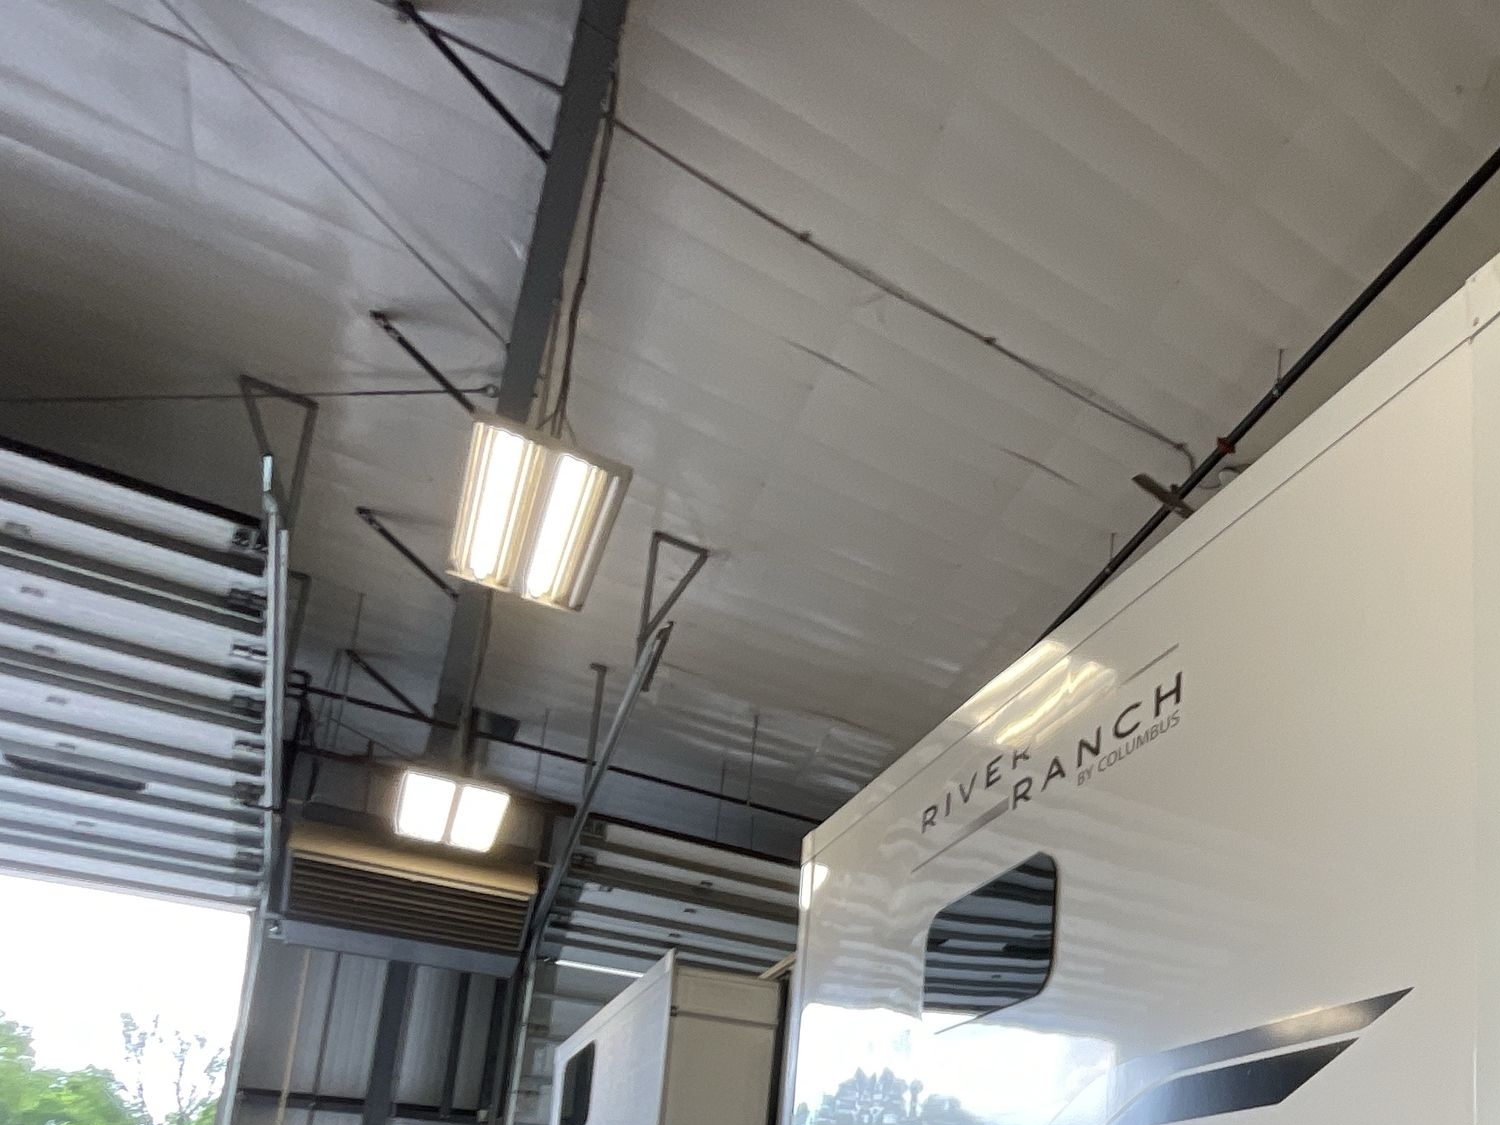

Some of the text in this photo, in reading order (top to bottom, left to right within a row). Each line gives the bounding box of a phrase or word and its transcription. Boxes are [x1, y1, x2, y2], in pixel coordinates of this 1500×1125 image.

[1012, 671, 1182, 809] RANCH
[1076, 709, 1180, 786] BY COLUMBUS
